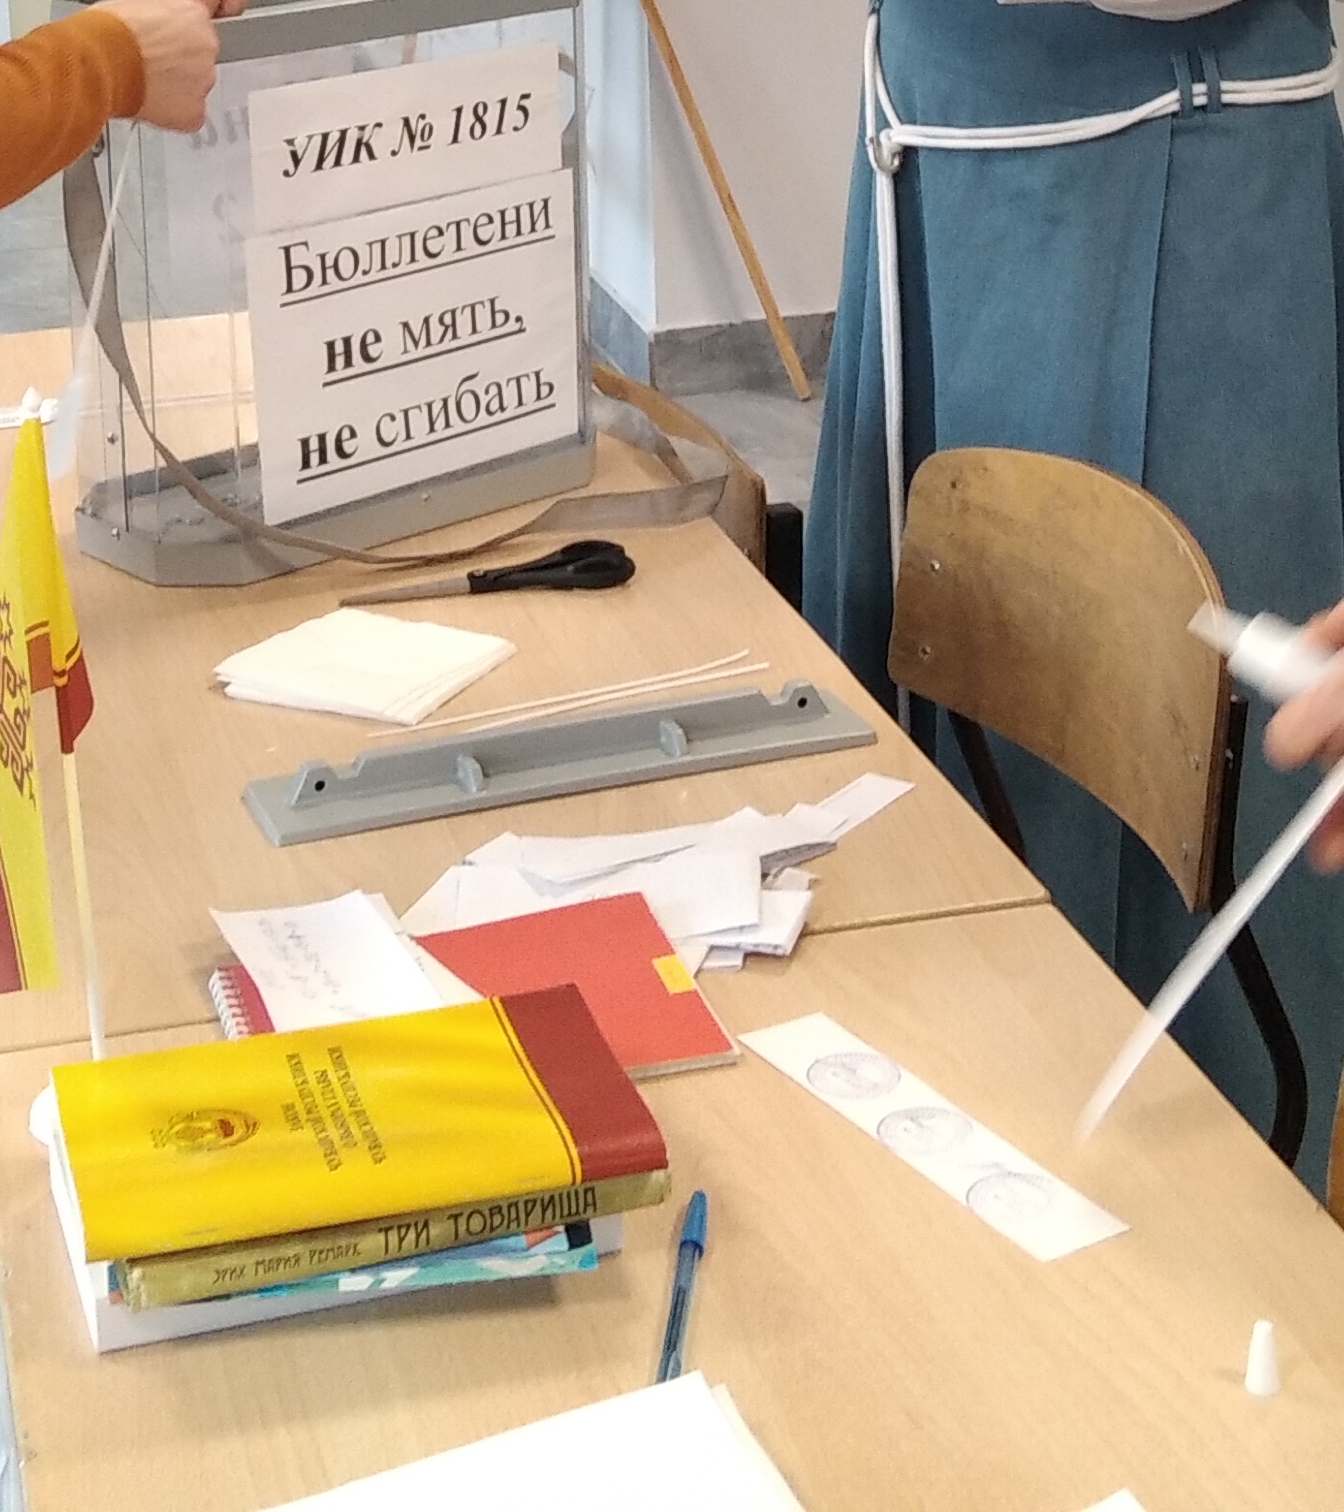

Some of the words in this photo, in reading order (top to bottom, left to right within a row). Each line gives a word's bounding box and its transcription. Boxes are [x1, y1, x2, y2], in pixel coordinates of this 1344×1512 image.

[282, 122, 383, 178] УИК
[391, 113, 434, 156] №
[447, 92, 532, 145] 1815
[278, 195, 554, 296] Бюллетени
[322, 327, 383, 375] не
[399, 295, 525, 355] мять,
[297, 422, 358, 472] не
[374, 367, 554, 447] сгибать
[255, 1253, 301, 1276] МАРИЯ
[309, 1242, 361, 1265] РЕМАРК
[377, 1218, 431, 1255] ТРИ
